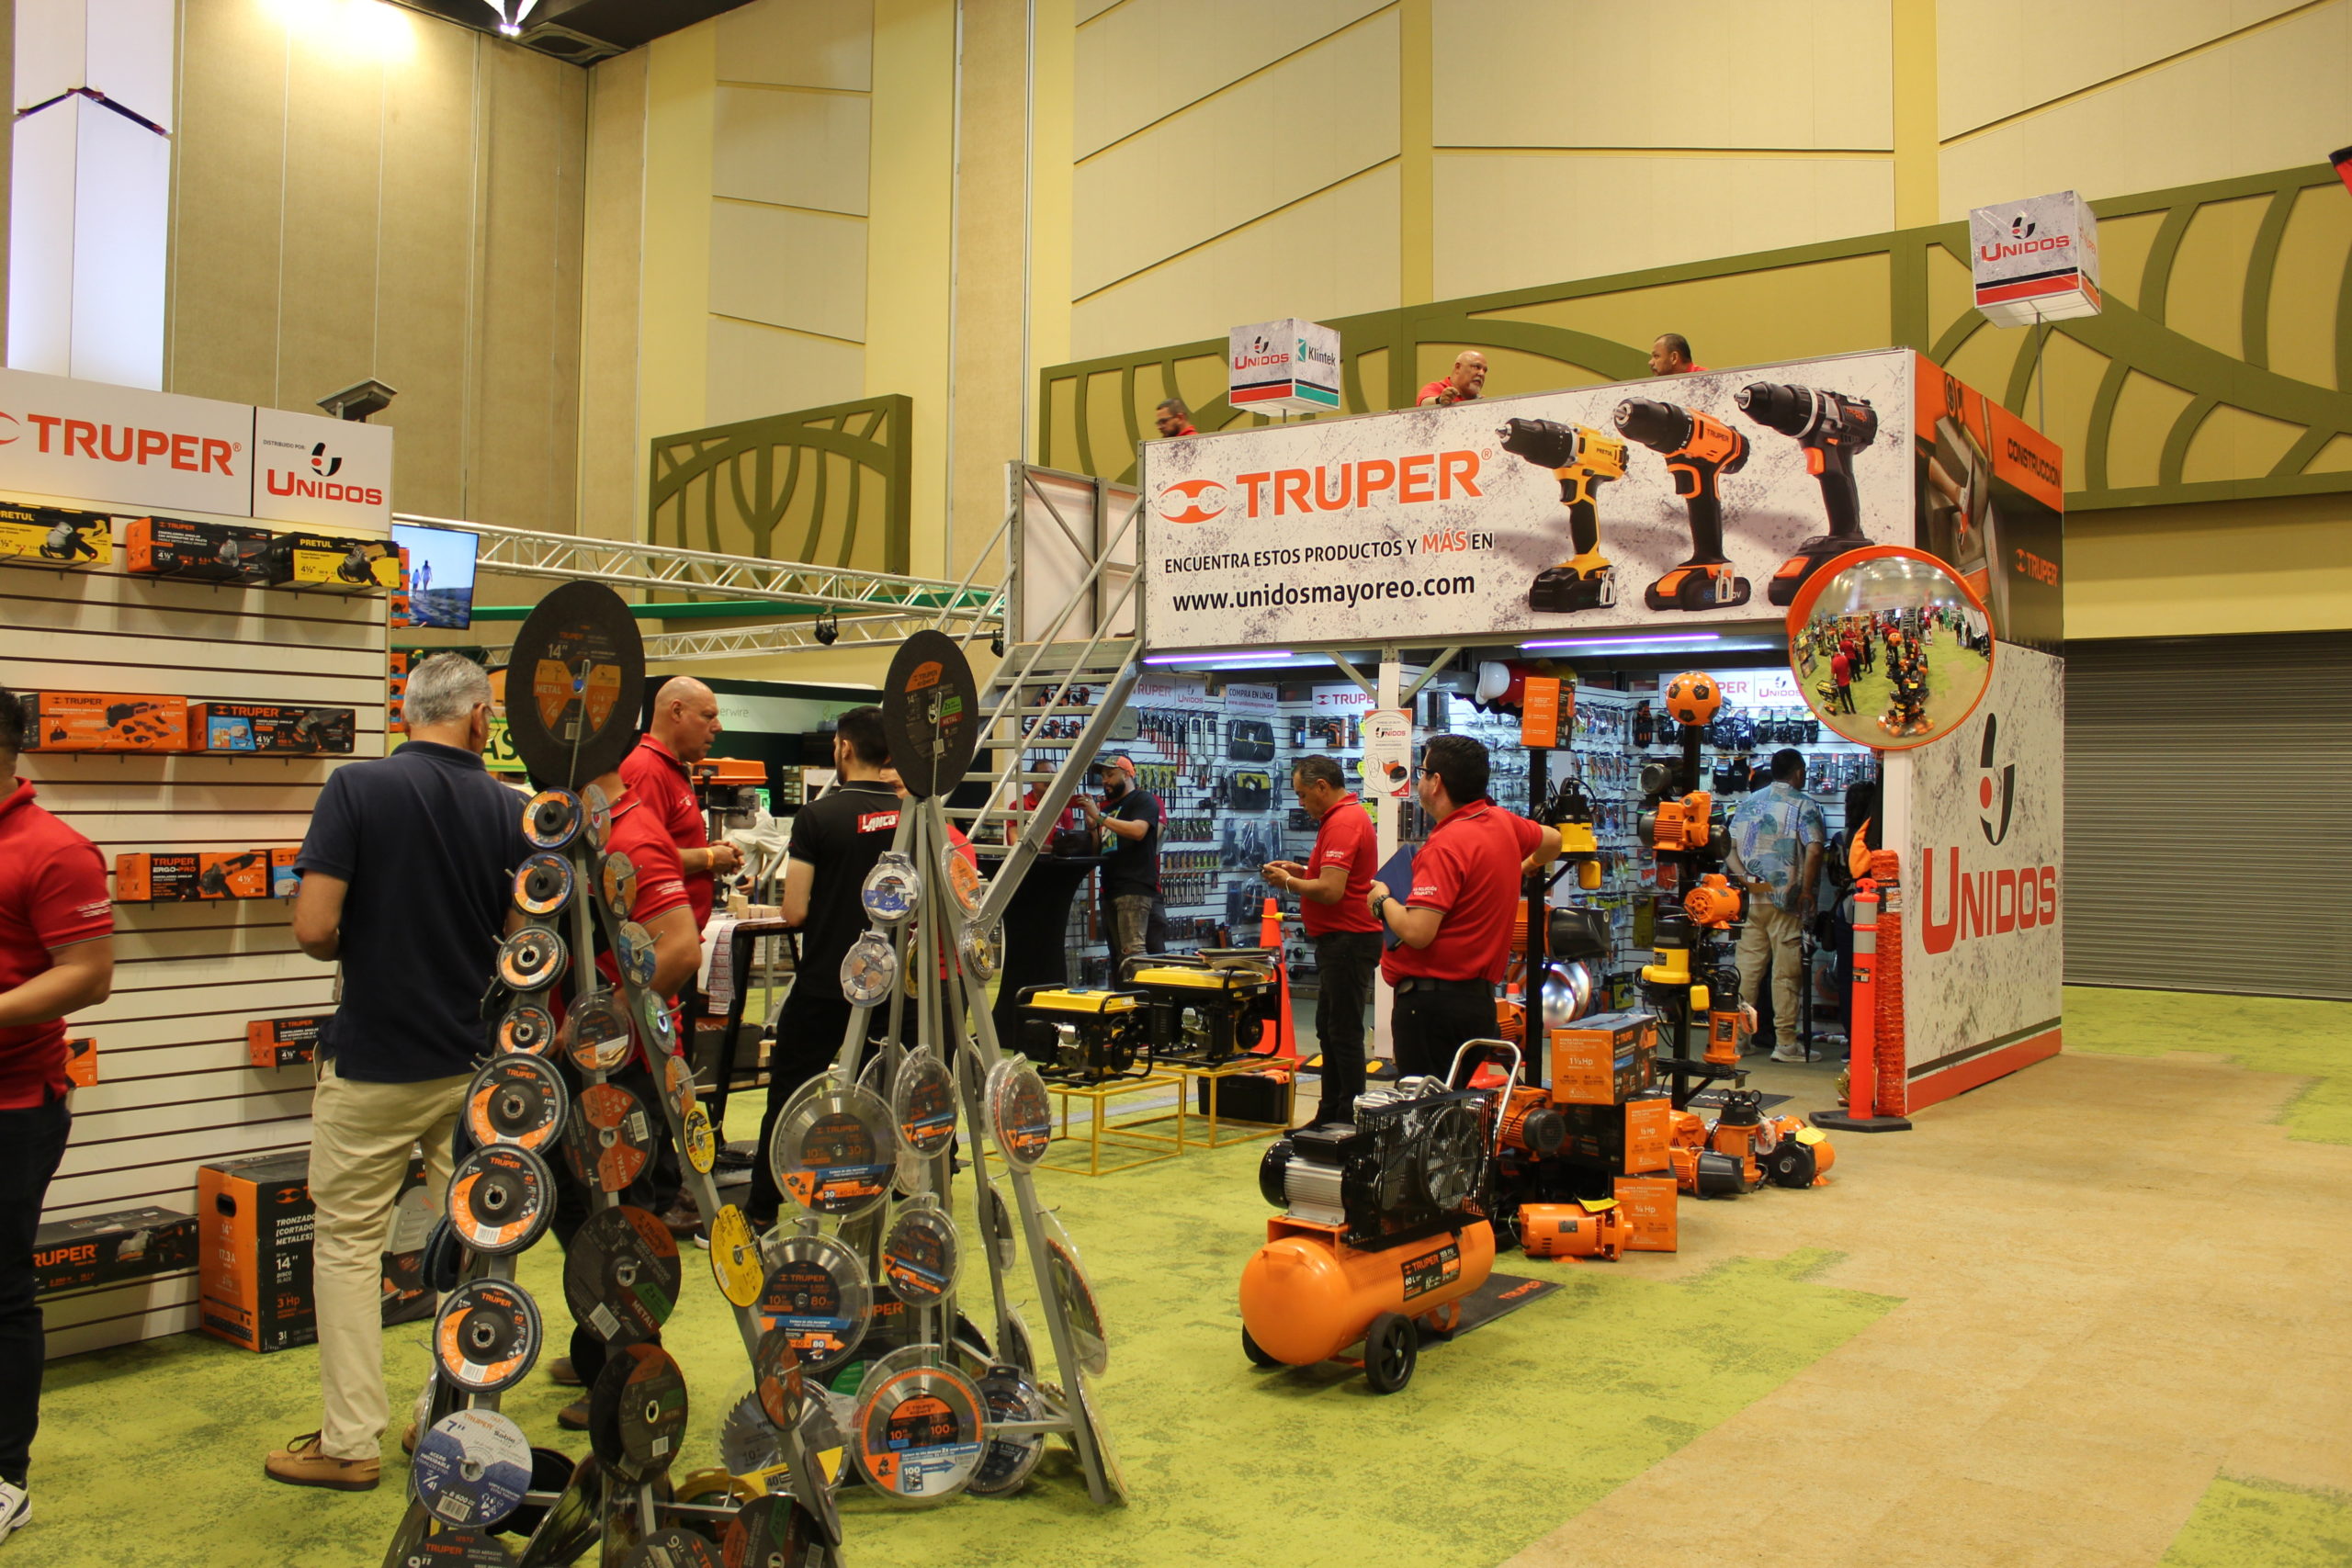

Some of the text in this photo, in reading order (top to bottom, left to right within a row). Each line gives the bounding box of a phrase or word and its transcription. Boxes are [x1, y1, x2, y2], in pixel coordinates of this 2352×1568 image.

[1981, 235, 2070, 262] UNIDOS
[1235, 354, 1289, 369] UNIDOS
[1308, 346, 1336, 367] Klintek
[1706, 428, 1729, 443] TRUPER
[28, 413, 234, 477] TRUPER
[263, 440, 295, 449] DISTRIBUIDO
[1596, 447, 1612, 457] PRETUL
[2007, 438, 2061, 489] CONSTRUCCIÓN
[267, 468, 382, 505] UNIDOS
[1236, 450, 1483, 517] TRUPER
[0, 511, 35, 521] RETUL
[167, 522, 195, 531] TRUPER
[300, 538, 333, 548] PRETUL
[1165, 527, 1493, 573] ENCUENTRA ESTOS PRODUCTOS Y MÁS EN
[2027, 553, 2058, 586] TRUPER
[1172, 575, 1475, 612] www.unidosmayoreo.com
[548, 643, 568, 659] 14"
[537, 684, 561, 694] METAL
[1229, 688, 1273, 700] COMPRA EN LÍNEA
[1716, 682, 1747, 694] PER
[1759, 688, 1801, 697] UNIDOS
[64, 697, 102, 705] TRUPER
[1178, 694, 1204, 704] UNIDOS
[1332, 694, 1374, 705] TRUPE
[231, 705, 279, 717] TRUPER
[719, 706, 749, 717] erwire
[863, 814, 895, 831] LANCO
[1922, 846, 2056, 955] UNIDOS
[1582, 1057, 1593, 1066] Hp
[505, 1068, 537, 1079] TRUPER
[490, 1156, 521, 1169] TRUPER
[1644, 1204, 1656, 1213] Hp
[276, 1213, 316, 1227] TRONZADO
[276, 1224, 314, 1237] [CORTADO
[276, 1233, 313, 1246] METALES]
[32, 1244, 96, 1268] RUPER
[1412, 1254, 1440, 1271] TRUPER
[277, 1270, 292, 1279] DISCO
[790, 1274, 826, 1282] TRUPER
[1498, 1281, 1544, 1299] TRUPER
[277, 1295, 300, 1308] 3 Hp
[481, 1292, 514, 1308] TRUPER
[811, 1296, 827, 1305] 80
[631, 1300, 653, 1328] METAL
[860, 1302, 905, 1318] UPER
[514, 1314, 524, 1323] 60
[812, 1340, 824, 1348] 80
[447, 1419, 466, 1432] 7"
[463, 1413, 494, 1430] TRUPER
[930, 1425, 950, 1435] 100
[429, 1451, 447, 1461] ACERO
[904, 1467, 921, 1475] 100
[425, 1542, 463, 1555] TRUPER
